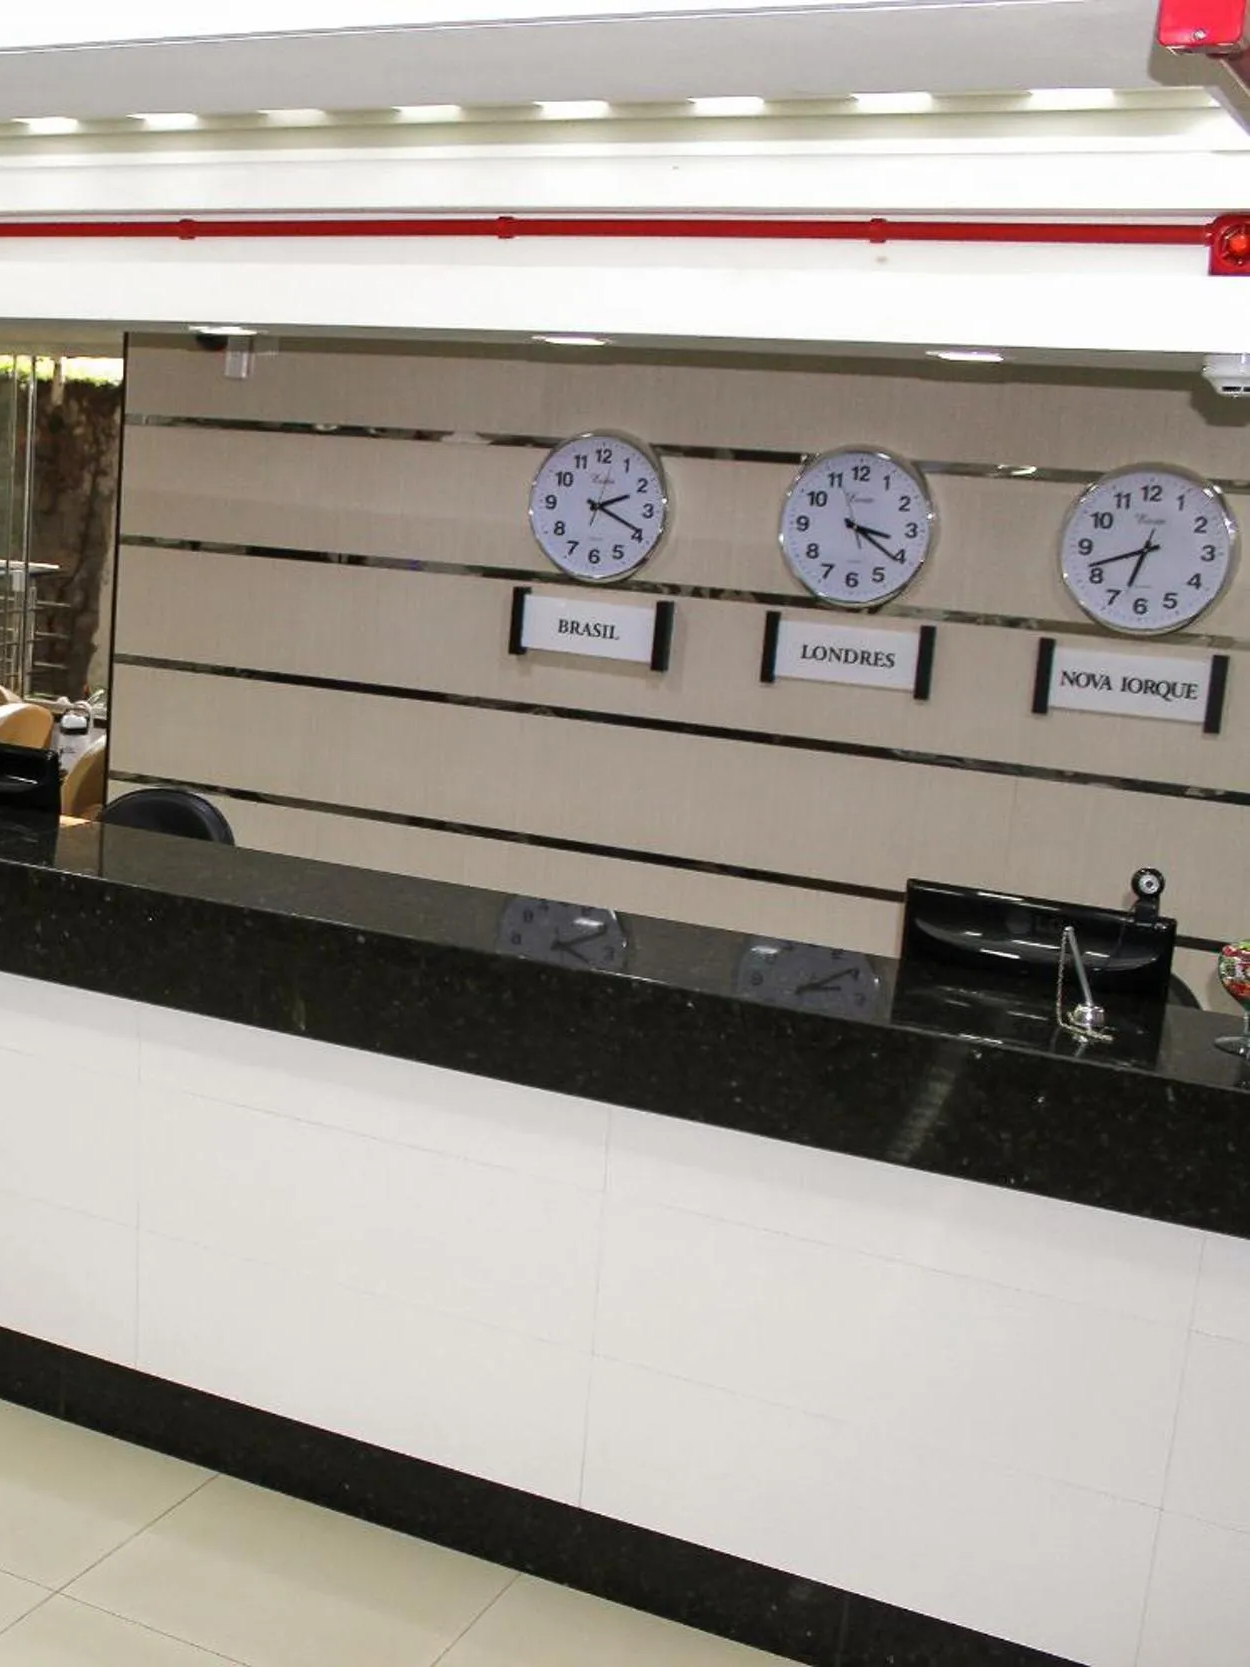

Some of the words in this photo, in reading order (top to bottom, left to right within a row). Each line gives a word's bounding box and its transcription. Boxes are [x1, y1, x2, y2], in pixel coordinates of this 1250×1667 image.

[574, 455, 587, 469] 11
[596, 449, 612, 464] 12
[624, 458, 630, 473] 1
[556, 472, 574, 486] 10
[828, 472, 843, 488] 11
[852, 466, 870, 481] 12
[637, 478, 648, 493] 2
[884, 476, 890, 491] 1
[807, 491, 827, 507] 10
[1114, 493, 1131, 509] 11
[1141, 485, 1162, 502] 12
[546, 495, 557, 509] 9
[899, 496, 911, 511] 2
[1177, 495, 1185, 511] 1
[642, 504, 654, 518] 3
[554, 521, 565, 535] 8
[796, 516, 809, 531] 9
[1091, 512, 1113, 529] 10
[1194, 516, 1208, 533] 2
[631, 529, 642, 543] 4
[905, 523, 918, 538] 3
[567, 541, 579, 555] 7
[613, 545, 624, 559] 5
[806, 543, 819, 559] 8
[1078, 539, 1093, 555] 9
[1201, 545, 1215, 562] 3
[589, 549, 600, 563] 6
[893, 549, 906, 564] 4
[821, 564, 835, 579] 7
[872, 567, 885, 582] 5
[1089, 568, 1103, 584] 8
[845, 573, 858, 587] 6
[1187, 574, 1202, 590] 4
[1106, 590, 1121, 605] 7
[1163, 593, 1178, 609] 5
[1133, 598, 1148, 614] 6
[558, 619, 620, 640] BRASIL
[800, 644, 896, 669] LONDRES
[1060, 670, 1112, 691] NOVA
[1120, 676, 1198, 702] IORQUE
